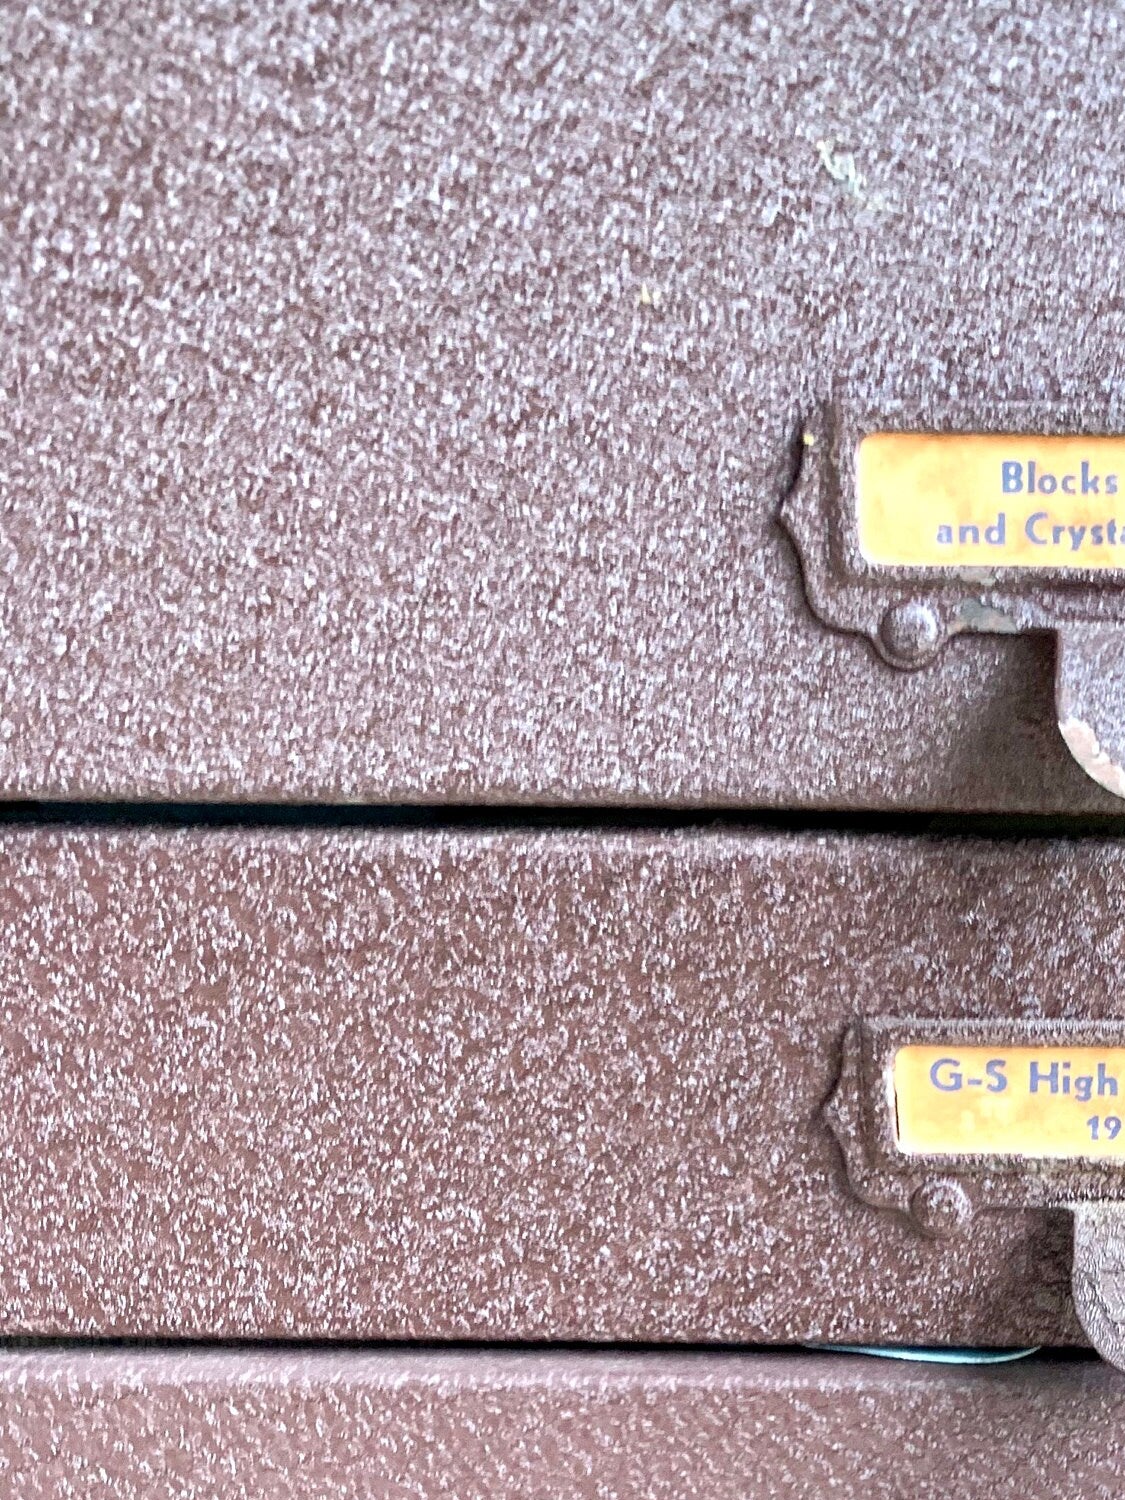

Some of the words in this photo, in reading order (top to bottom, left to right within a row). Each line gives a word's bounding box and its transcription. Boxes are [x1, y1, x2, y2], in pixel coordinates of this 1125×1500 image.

[1001, 460, 1118, 495] Blocks
[936, 512, 1006, 545] and
[929, 1057, 1009, 1093] G-S
[1029, 1061, 1119, 1102] High
